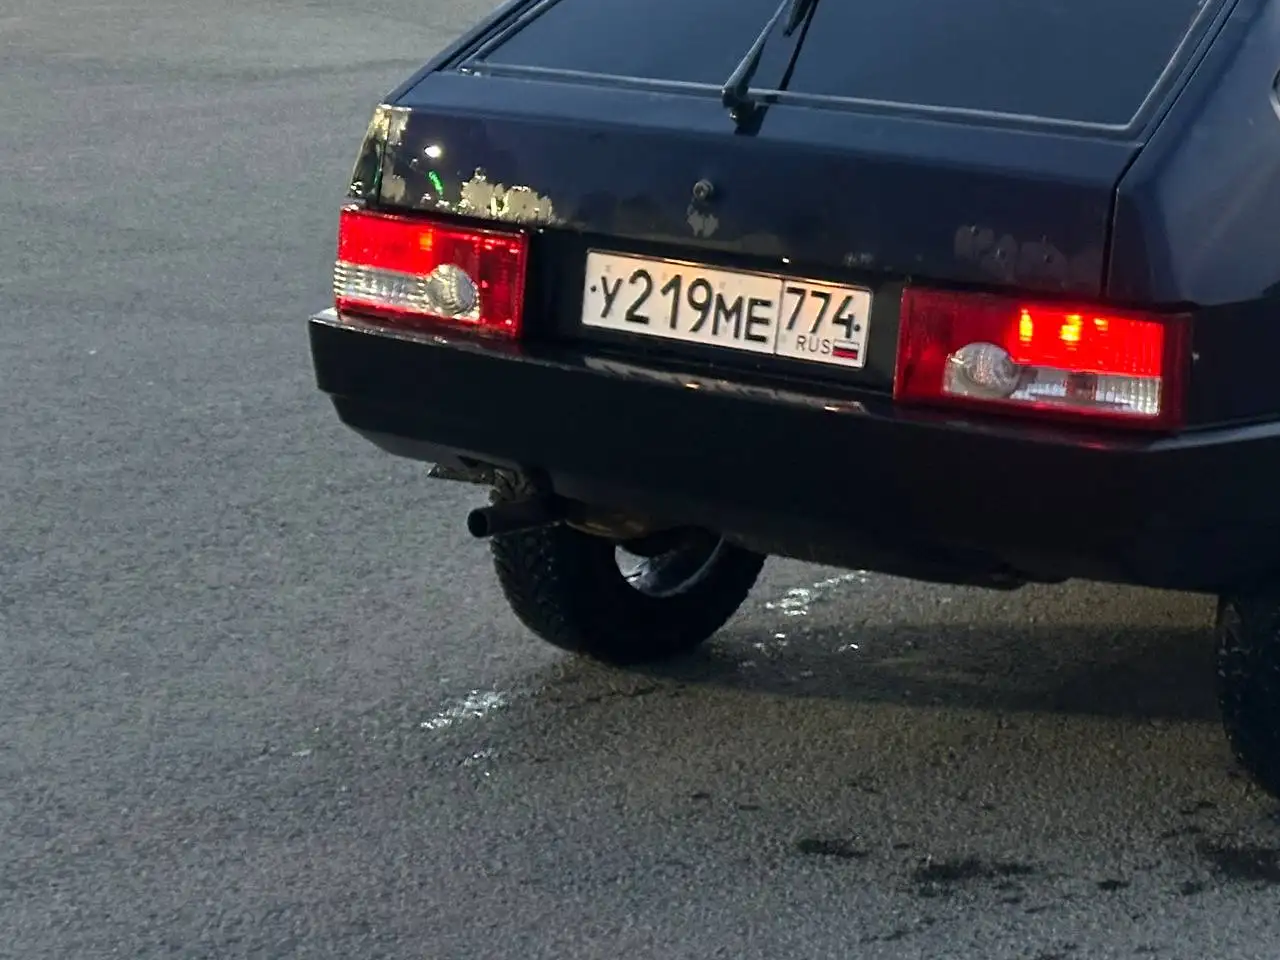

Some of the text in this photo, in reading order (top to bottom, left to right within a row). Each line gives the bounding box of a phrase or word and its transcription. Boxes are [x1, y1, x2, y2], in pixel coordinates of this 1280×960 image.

[599, 268, 854, 343] У219МЕ 774
[795, 334, 831, 355] RUS
